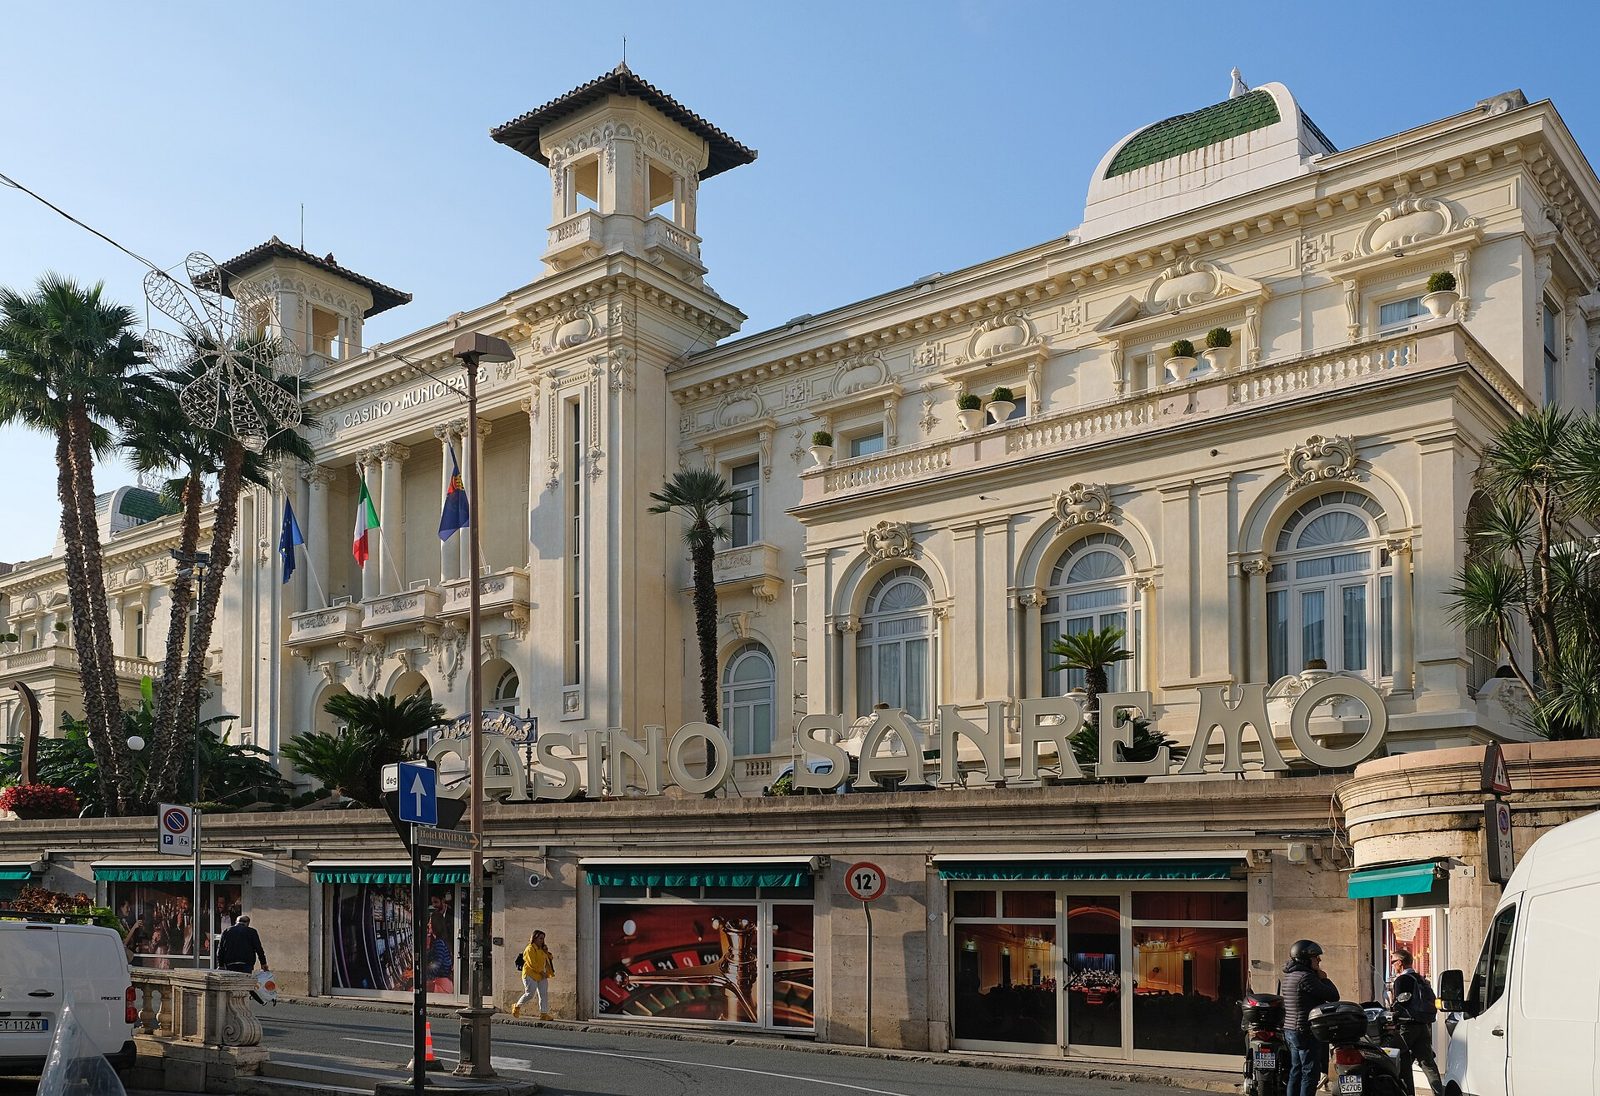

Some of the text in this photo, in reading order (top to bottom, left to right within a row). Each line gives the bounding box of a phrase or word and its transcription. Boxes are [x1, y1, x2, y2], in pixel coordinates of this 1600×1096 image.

[343, 366, 489, 428] CASINO MUNICIPAE
[427, 678, 1389, 802] CASINO SANREMO
[420, 829, 437, 841] Hotel
[438, 831, 469, 844] RIVIERA
